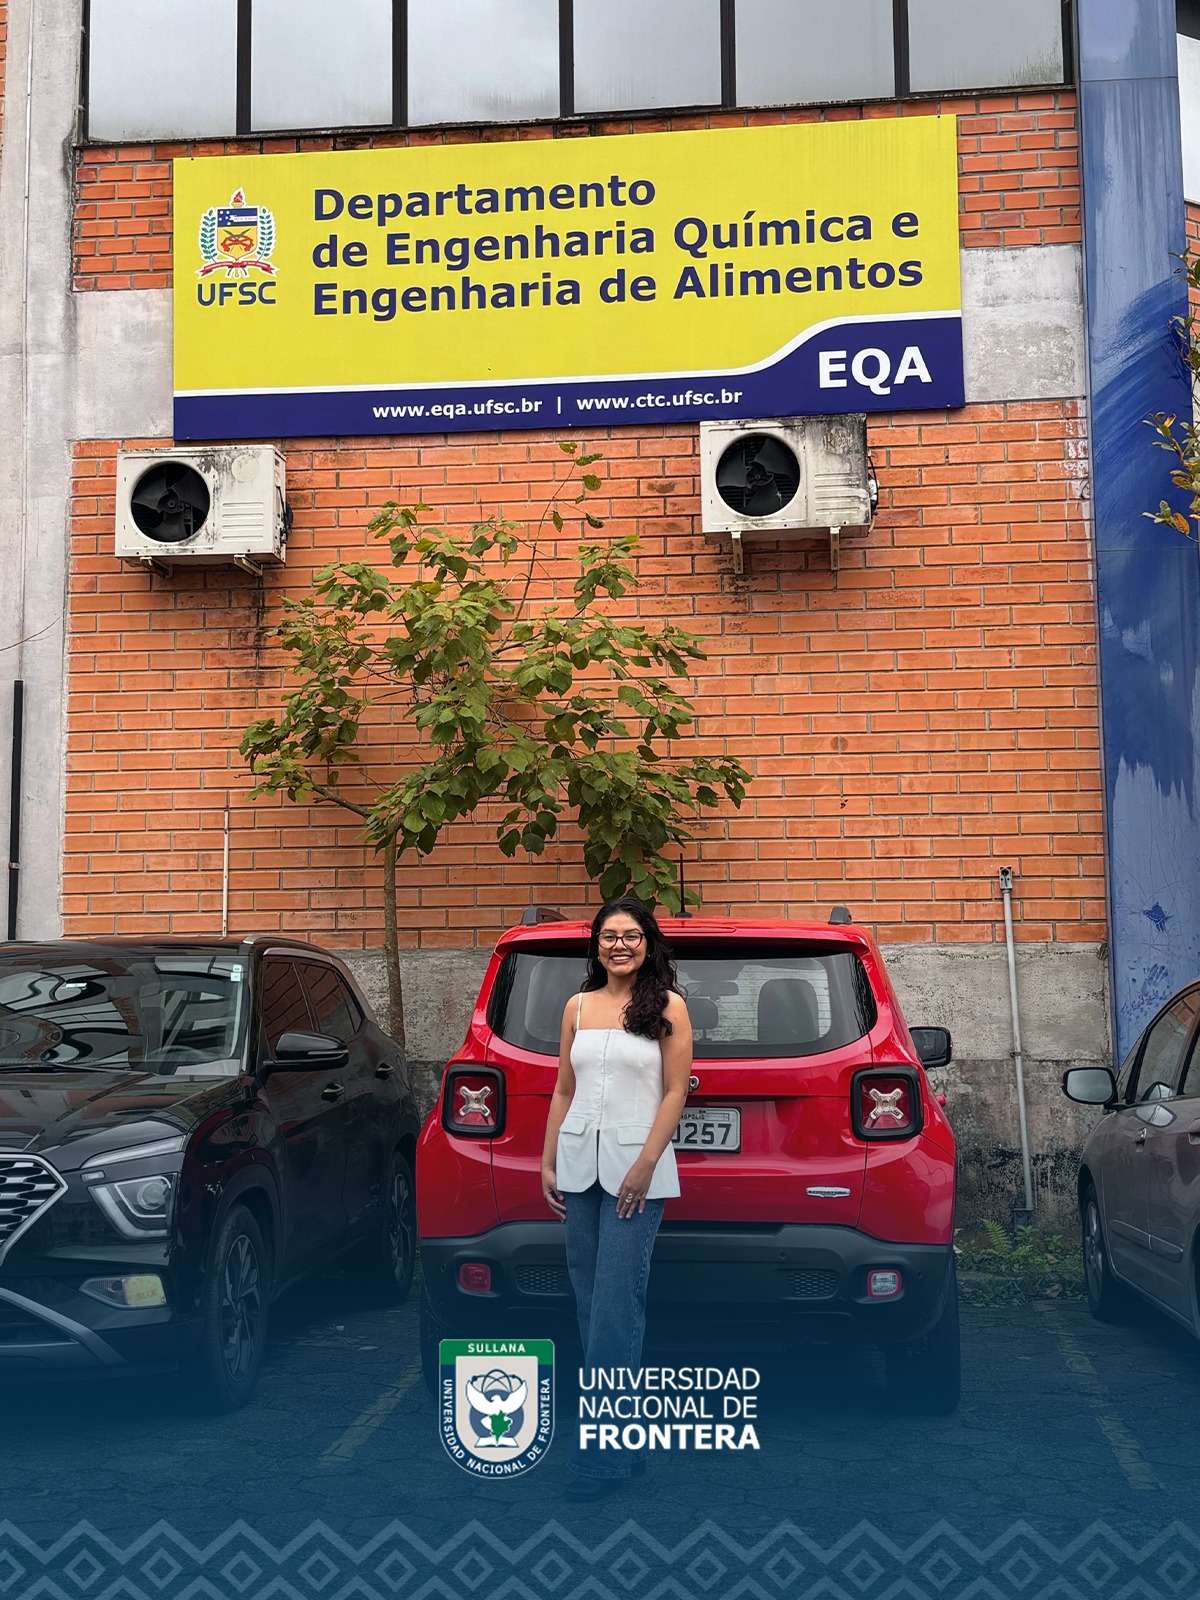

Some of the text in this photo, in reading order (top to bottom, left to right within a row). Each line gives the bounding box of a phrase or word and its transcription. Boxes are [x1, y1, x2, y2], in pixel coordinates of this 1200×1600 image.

[314, 175, 656, 227] Departamento
[312, 209, 919, 272] de Engenharia Química e
[197, 281, 277, 307] UFSC
[314, 257, 923, 322] Engenharia de Alimentos
[818, 346, 933, 395] EQA
[372, 397, 543, 419] www.eqa.ufsc.br
[577, 388, 743, 410] www.ctc.ufsc.br
